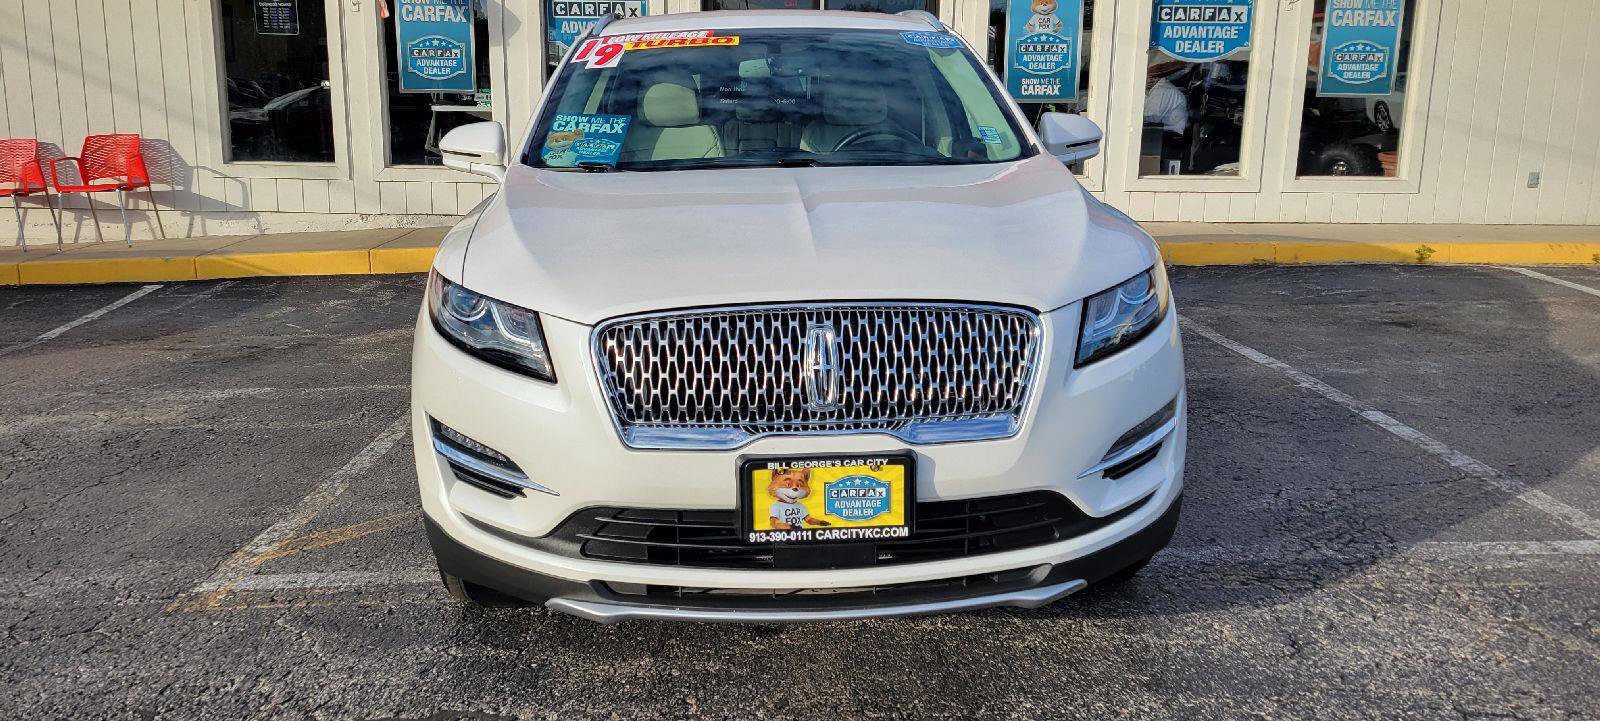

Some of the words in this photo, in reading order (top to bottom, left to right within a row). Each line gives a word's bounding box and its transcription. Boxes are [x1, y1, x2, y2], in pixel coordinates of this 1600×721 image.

[402, 5, 467, 22] CARFAX
[555, 3, 638, 18] CARFAX
[1160, 7, 1245, 22] CARFAX
[1332, 10, 1396, 26] CARFAX
[607, 35, 640, 43] LOW
[642, 31, 708, 41] MILEAGE
[1164, 26, 1239, 38] ADVANTAGE
[632, 37, 735, 48] TURBO
[1175, 41, 1224, 53] DEALER
[412, 48, 460, 58] CARFAX
[575, 40, 624, 66] 19
[1020, 45, 1066, 53] CARFAX
[416, 59, 457, 67] ADVANTAGE
[1023, 54, 1062, 62] ADVANTAGE
[1335, 54, 1383, 62] CARFAX
[423, 67, 451, 75] DEALER
[1029, 62, 1055, 70] DEALER
[1022, 85, 1061, 95] CARFAX
[556, 114, 589, 123] SHOW
[553, 121, 624, 133] CARFAX
[767, 462, 789, 470] BILL
[791, 460, 841, 469] GEORGE'S
[866, 459, 888, 467] CITY
[830, 488, 885, 498] CARFAX
[834, 500, 882, 509] ADVANTAGE
[784, 508, 801, 517] CAR
[842, 509, 874, 517] DEALER
[785, 517, 802, 525] FOX
[749, 531, 812, 542] 913-390-0111
[815, 527, 909, 540] CARCITYKC.COM
